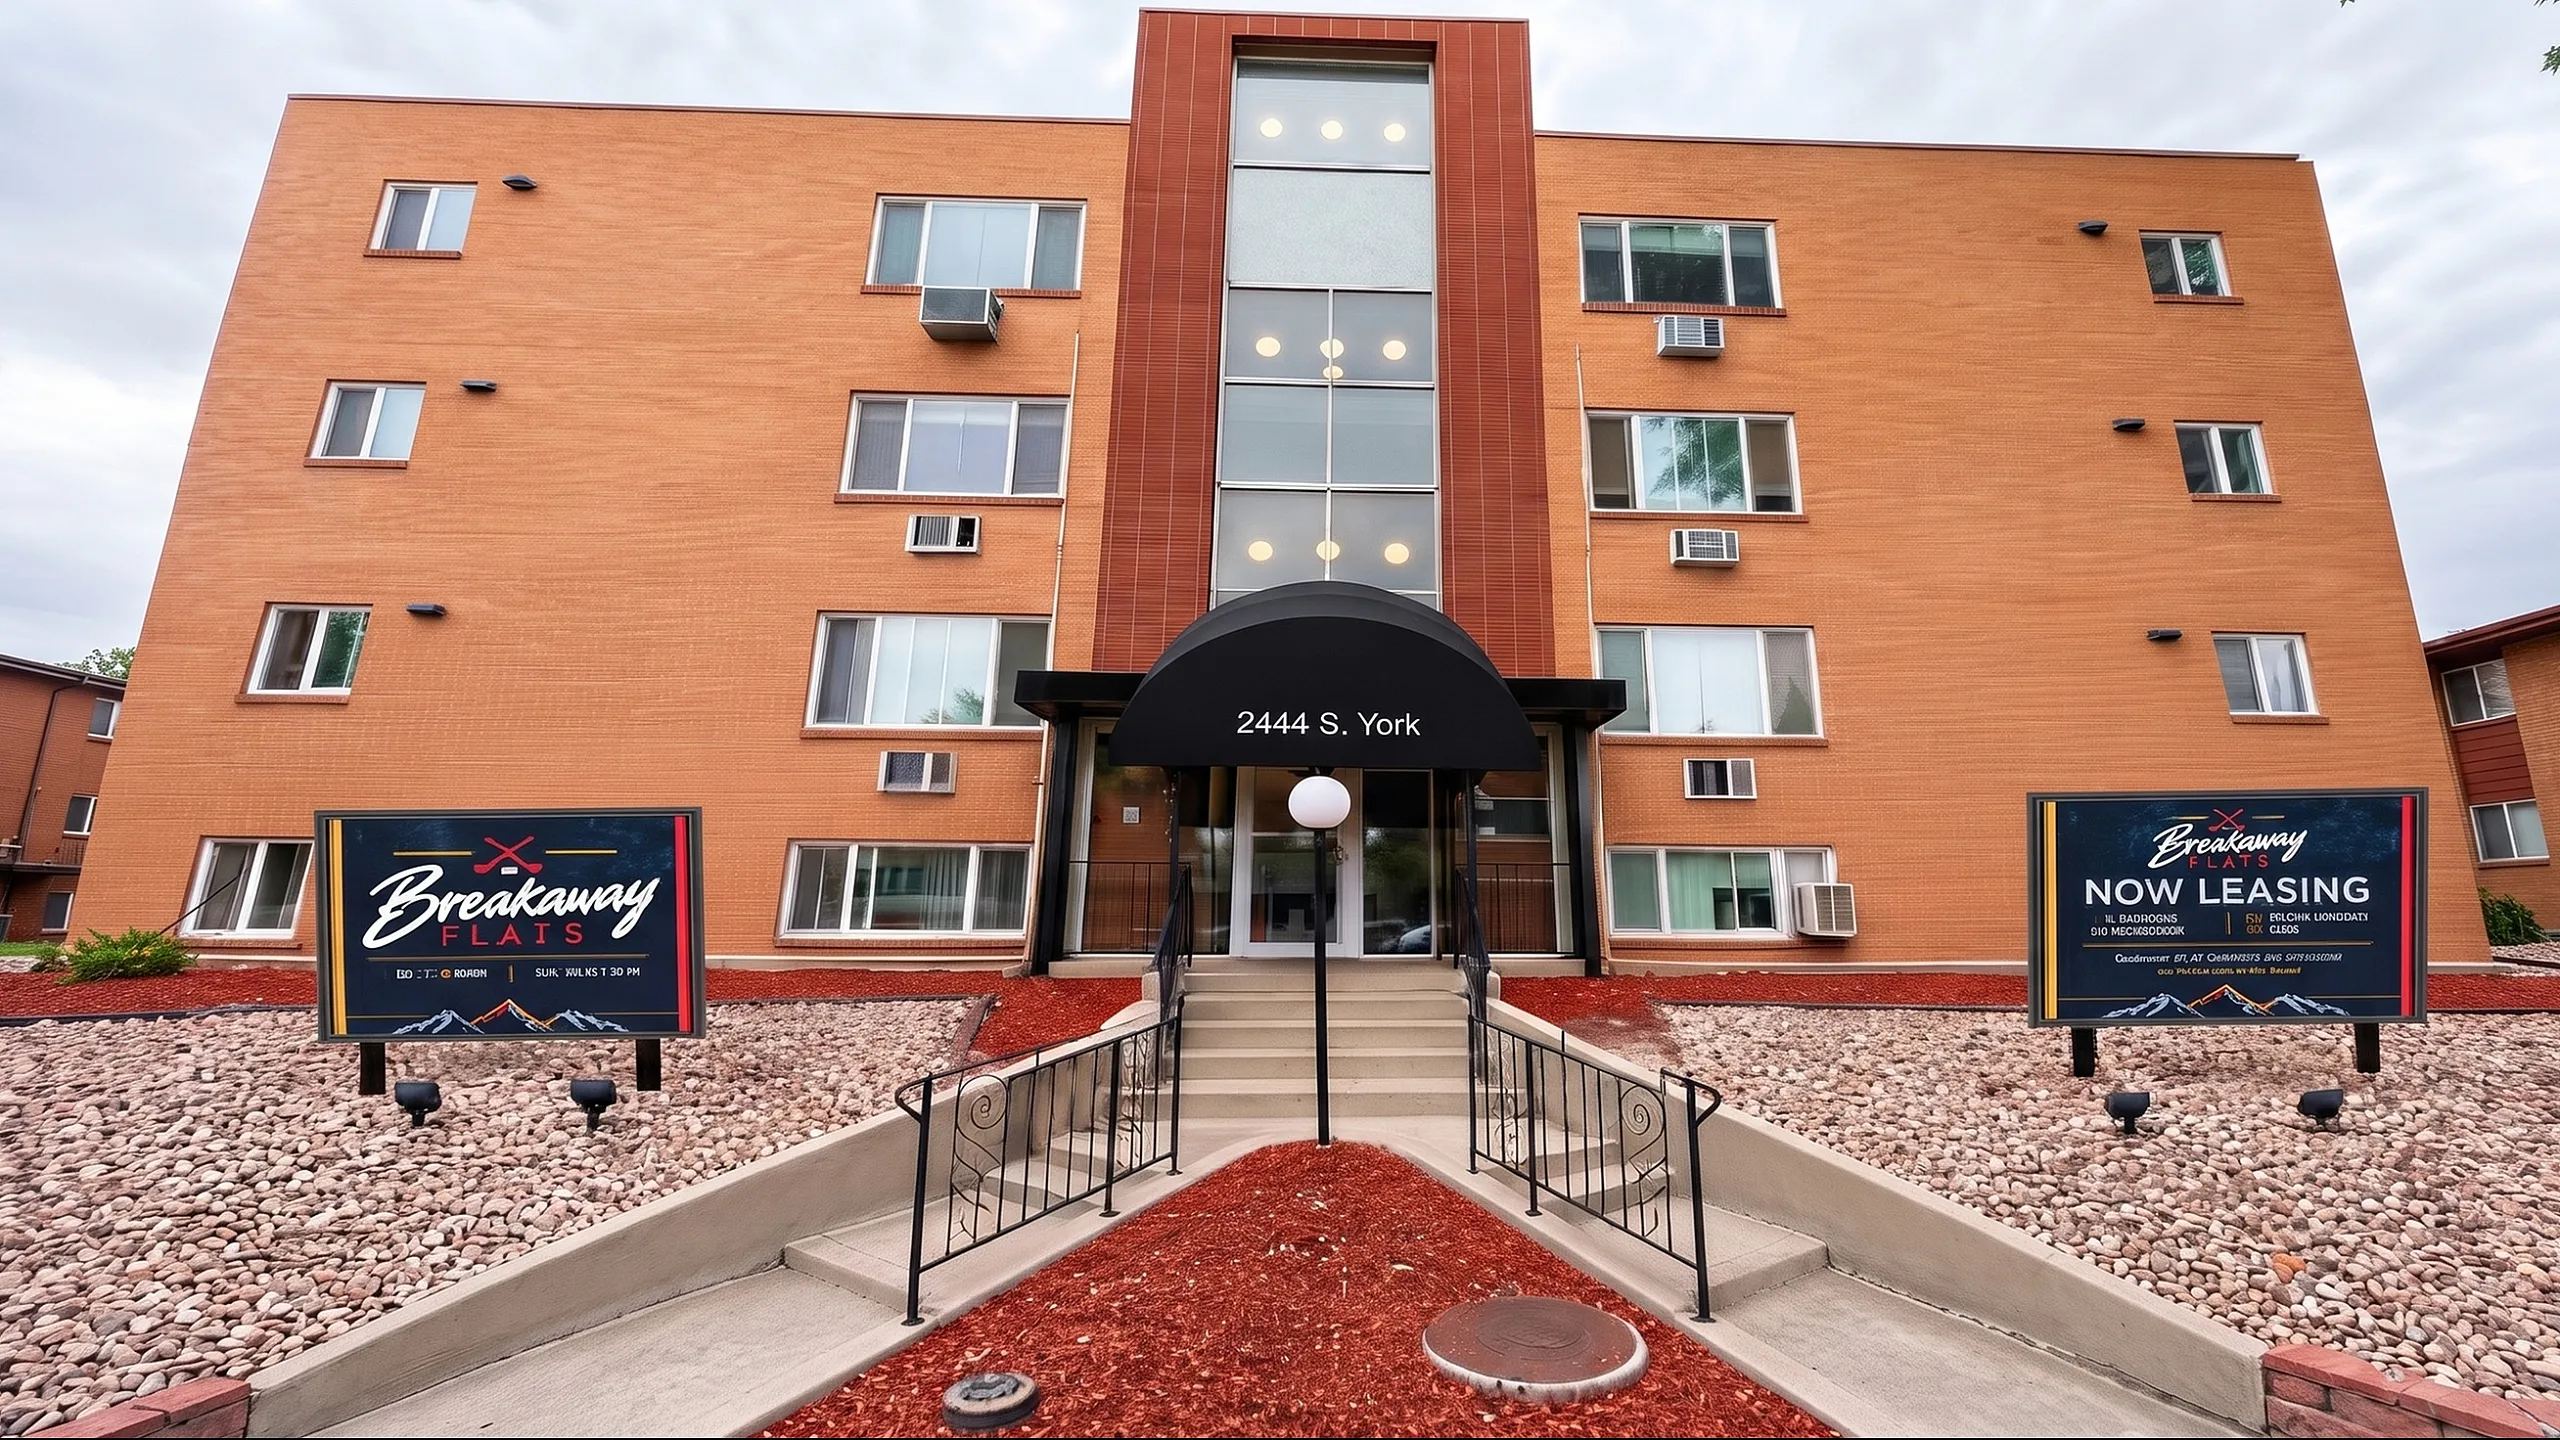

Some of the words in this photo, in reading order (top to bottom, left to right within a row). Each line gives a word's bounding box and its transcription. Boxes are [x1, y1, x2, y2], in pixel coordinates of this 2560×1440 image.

[1237, 711, 1309, 734] 2444
[1319, 712, 1348, 736] S.
[1357, 712, 1421, 736] York
[2147, 823, 2308, 869] Breakaway
[2189, 854, 2269, 869] FLATS
[2084, 878, 2184, 905] NOW
[2199, 876, 2370, 905] LEASING
[361, 863, 662, 949] Breakaway
